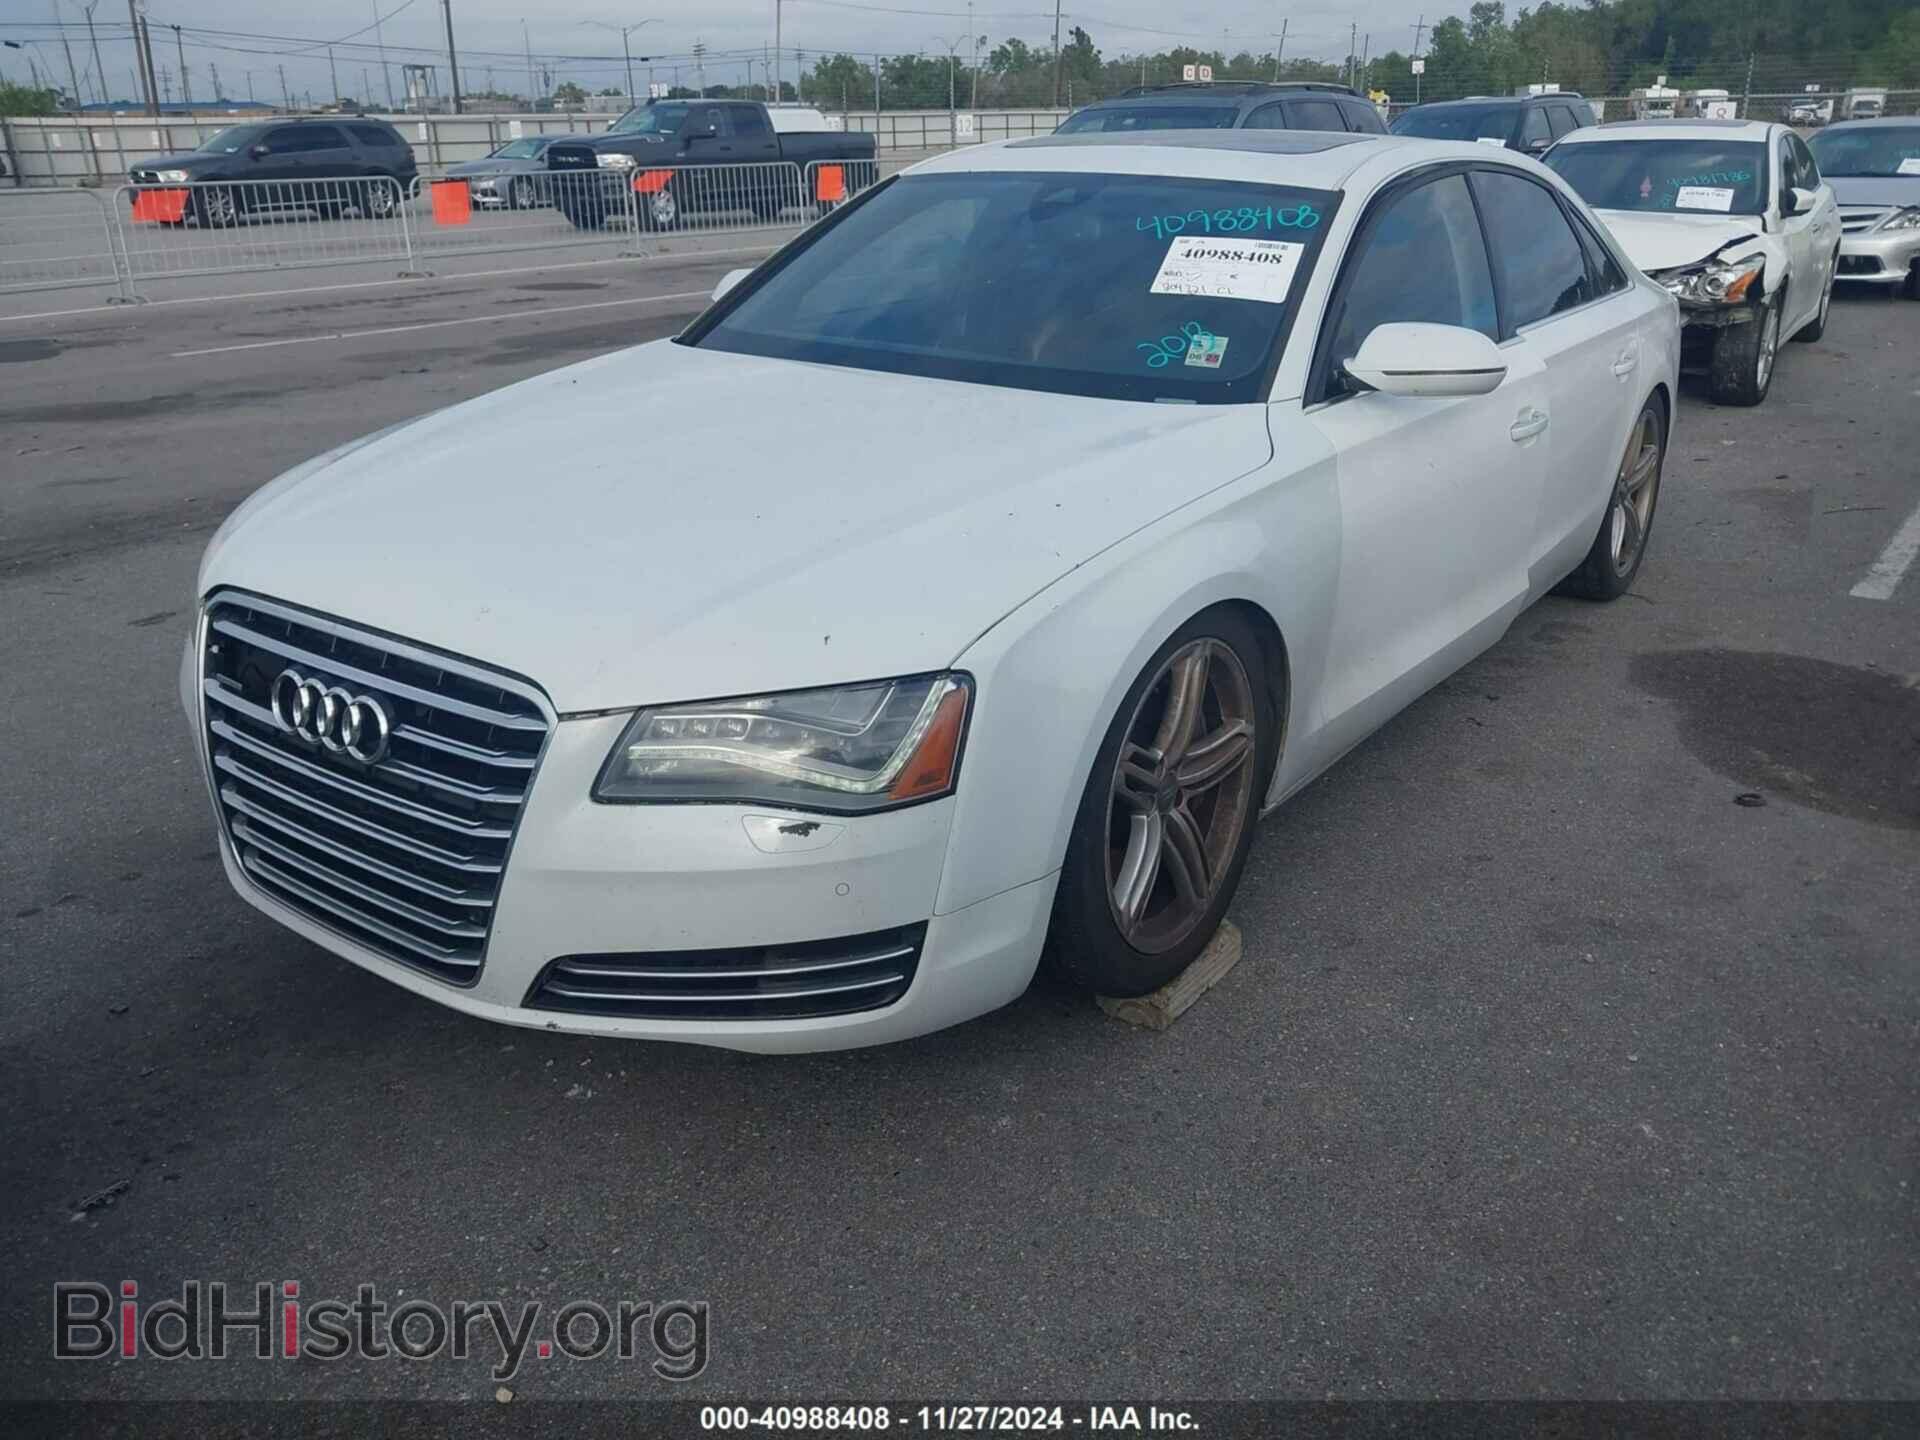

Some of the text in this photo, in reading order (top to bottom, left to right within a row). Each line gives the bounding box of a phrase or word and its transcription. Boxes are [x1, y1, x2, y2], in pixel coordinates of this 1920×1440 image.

[959, 119, 972, 133] 12
[1136, 205, 1320, 239] 40988408
[1181, 248, 1283, 265] 40988408
